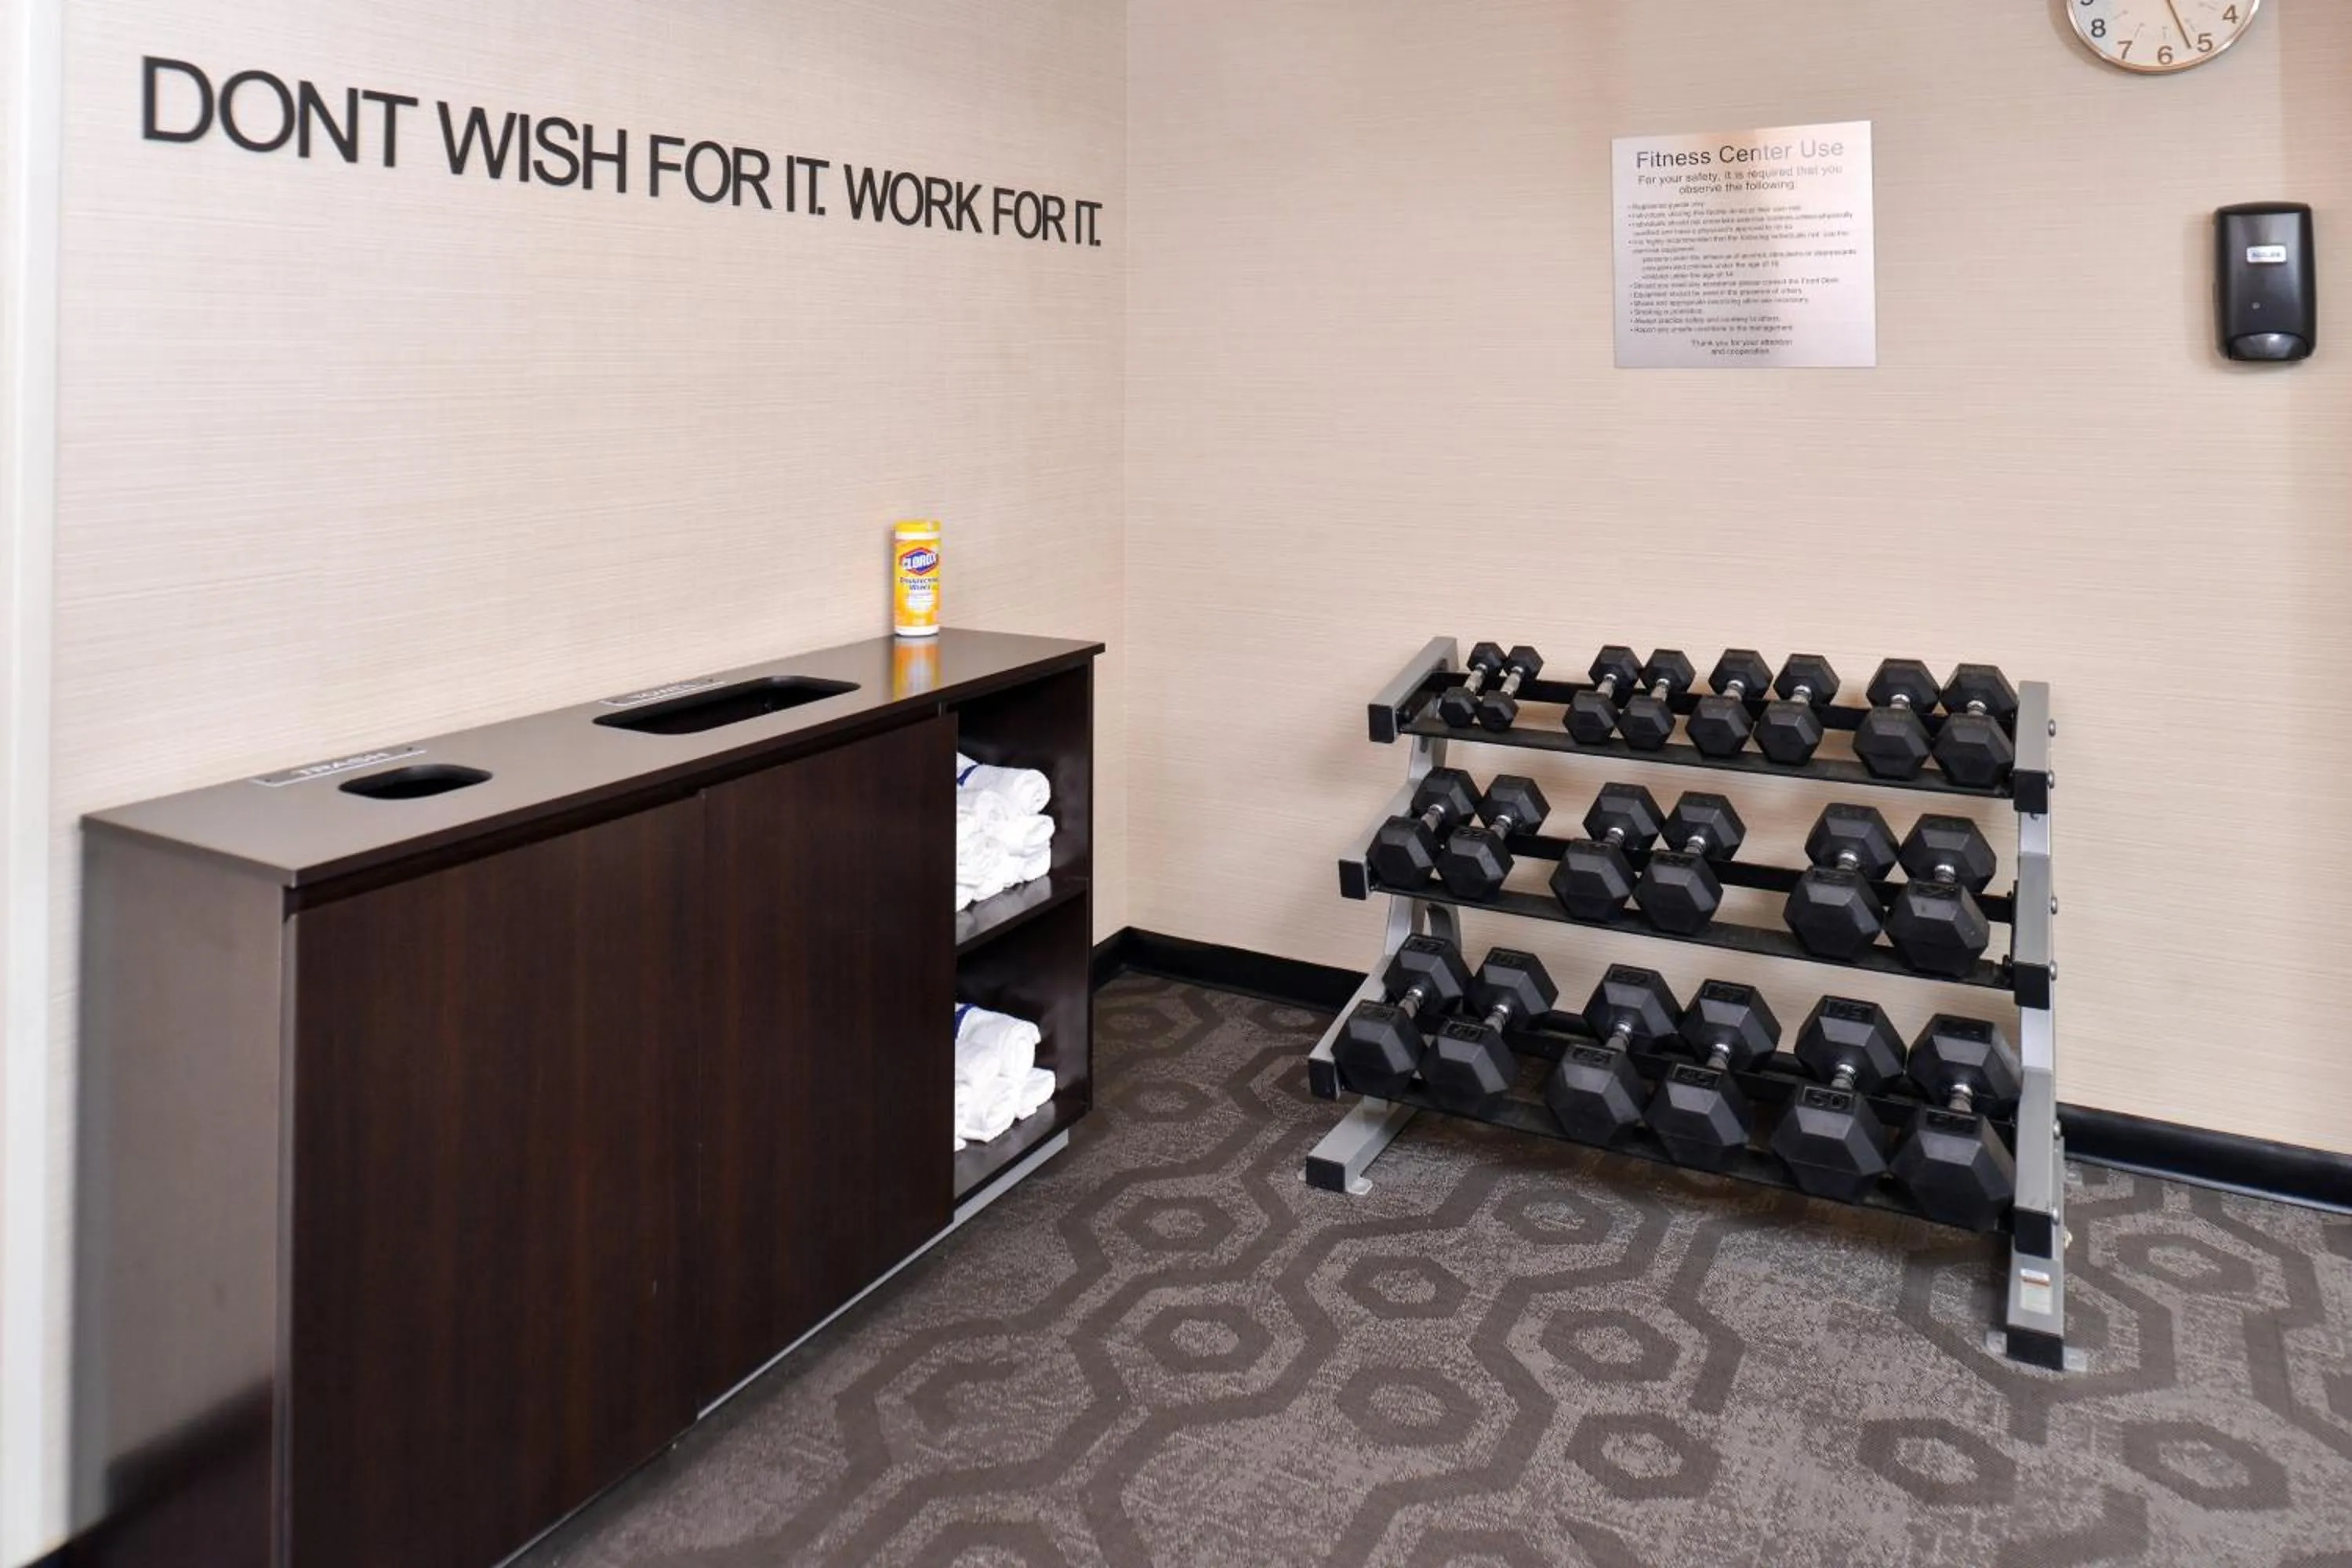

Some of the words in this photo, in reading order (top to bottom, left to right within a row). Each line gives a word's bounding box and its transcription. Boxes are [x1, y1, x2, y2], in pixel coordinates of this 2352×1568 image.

[2222, 5, 2239, 24] 4
[2091, 18, 2106, 38] 8
[2118, 41, 2133, 60] 7
[2197, 32, 2213, 53] 5
[2158, 45, 2173, 65] 6
[142, 55, 419, 168] DONT
[437, 100, 627, 194] WISH
[649, 134, 772, 210] FOR
[786, 155, 829, 216] IT.
[844, 164, 983, 234] WORK
[993, 186, 1067, 242] FOR
[1075, 199, 1103, 247] IT.
[1636, 150, 1711, 169] Fitness
[1719, 144, 1792, 163] Center
[1801, 139, 1844, 158] Use
[1638, 175, 1656, 185] For
[1659, 174, 1682, 187] your
[1735, 170, 1744, 180] is
[1748, 166, 1793, 180] required
[1797, 165, 1819, 176] that
[1822, 165, 1842, 177] you
[1679, 183, 1723, 194] observe
[1726, 182, 1741, 193] the
